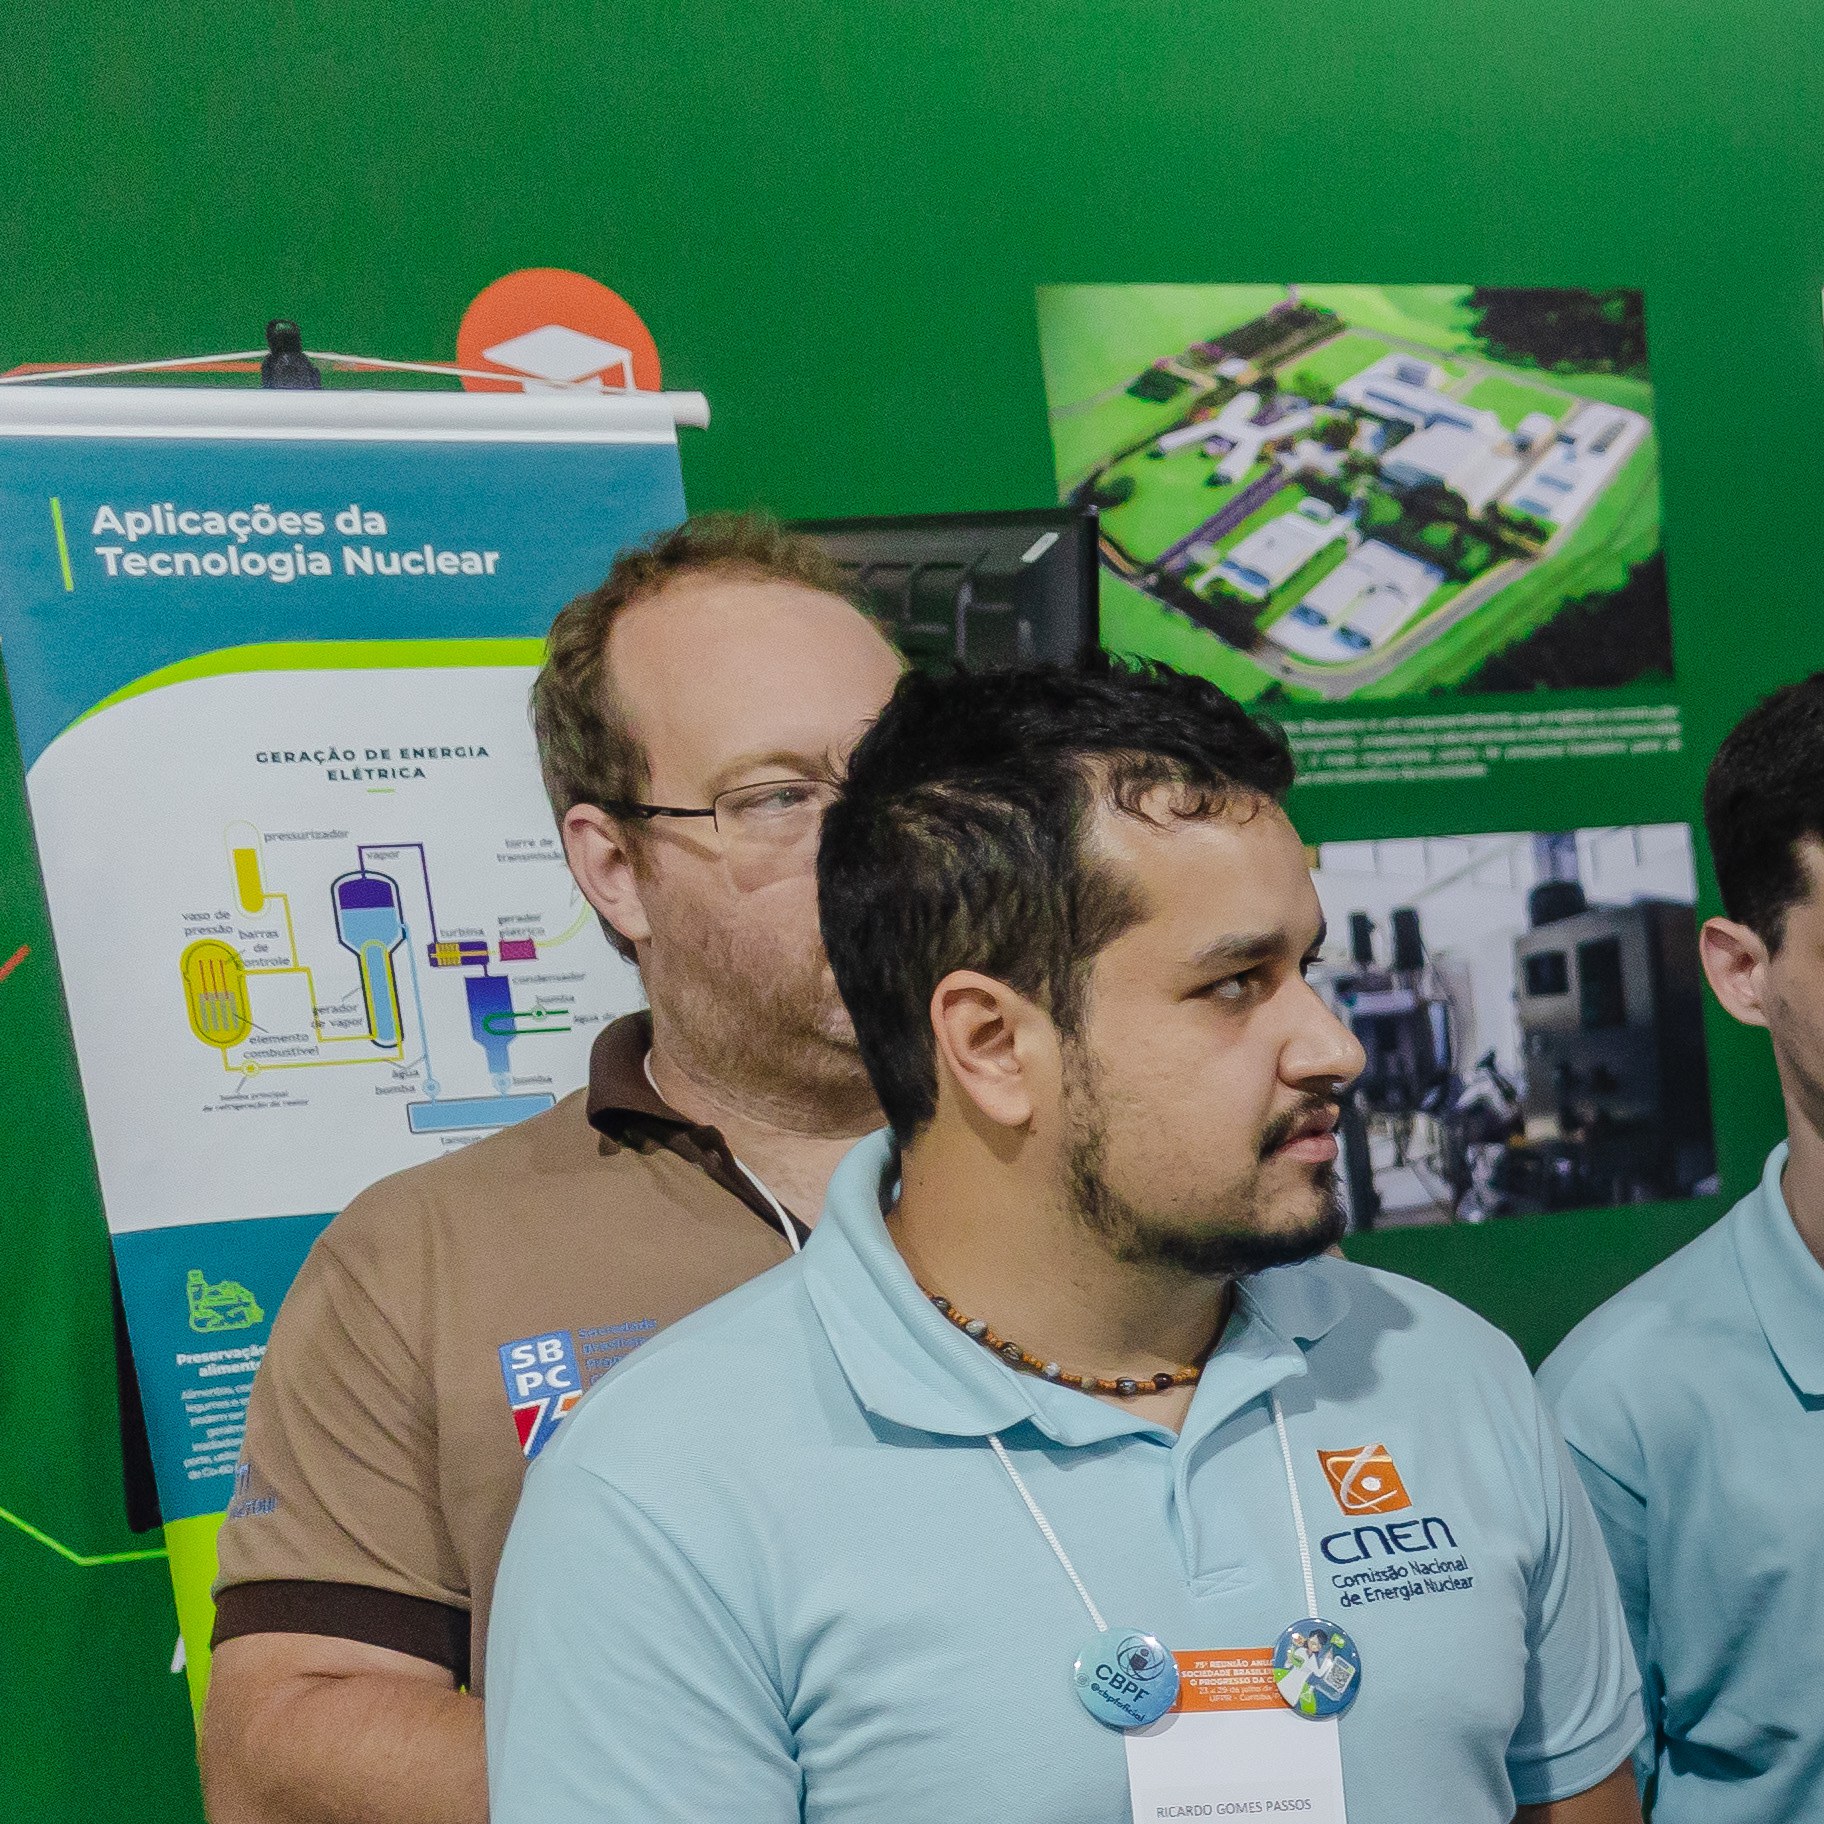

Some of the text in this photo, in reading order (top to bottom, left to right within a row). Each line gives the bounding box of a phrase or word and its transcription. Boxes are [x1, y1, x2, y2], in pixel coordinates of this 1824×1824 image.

[92, 503, 387, 542] Aplicações da
[95, 544, 500, 583] Tecnologia Nuclear
[256, 746, 489, 765] GERAÇÃO DE ENERGIA
[327, 766, 426, 781] ELÉTRICA
[511, 1339, 564, 1370] SB
[515, 1365, 572, 1397] PC
[1320, 1517, 1458, 1564] CNEN
[1332, 1555, 1469, 1589] Comissão Nacional
[1340, 1576, 1474, 1608] de Energia Nuclear
[1095, 1664, 1150, 1703] CBPF
[1198, 1677, 1251, 1687] PROGRESSO
[1156, 1798, 1312, 1818] RICARDO GOMES PASSOS
